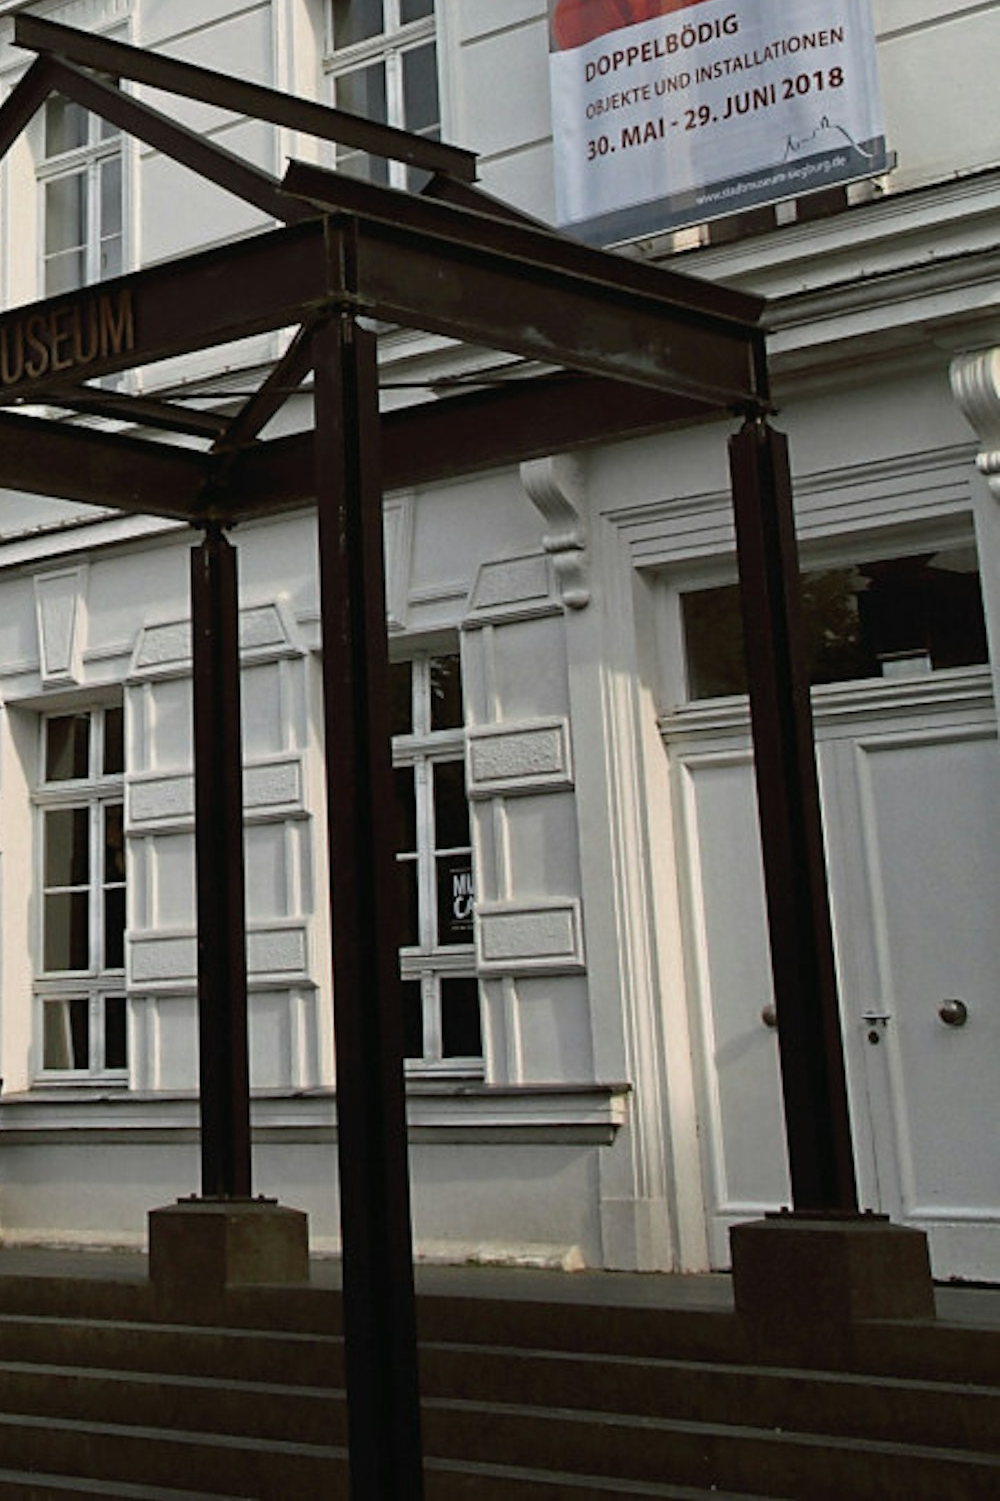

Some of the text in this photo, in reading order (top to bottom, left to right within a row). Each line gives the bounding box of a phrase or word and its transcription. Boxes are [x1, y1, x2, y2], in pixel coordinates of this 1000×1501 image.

[585, 13, 739, 83] DOPPELBÖDIG
[586, 26, 844, 119] OBJEKTE UND INSTALLATIONEN
[586, 134, 616, 160] 30.
[622, 118, 665, 150] MAI
[685, 105, 719, 131] 29.
[723, 84, 777, 120] JUNI
[781, 66, 844, 101] 2018
